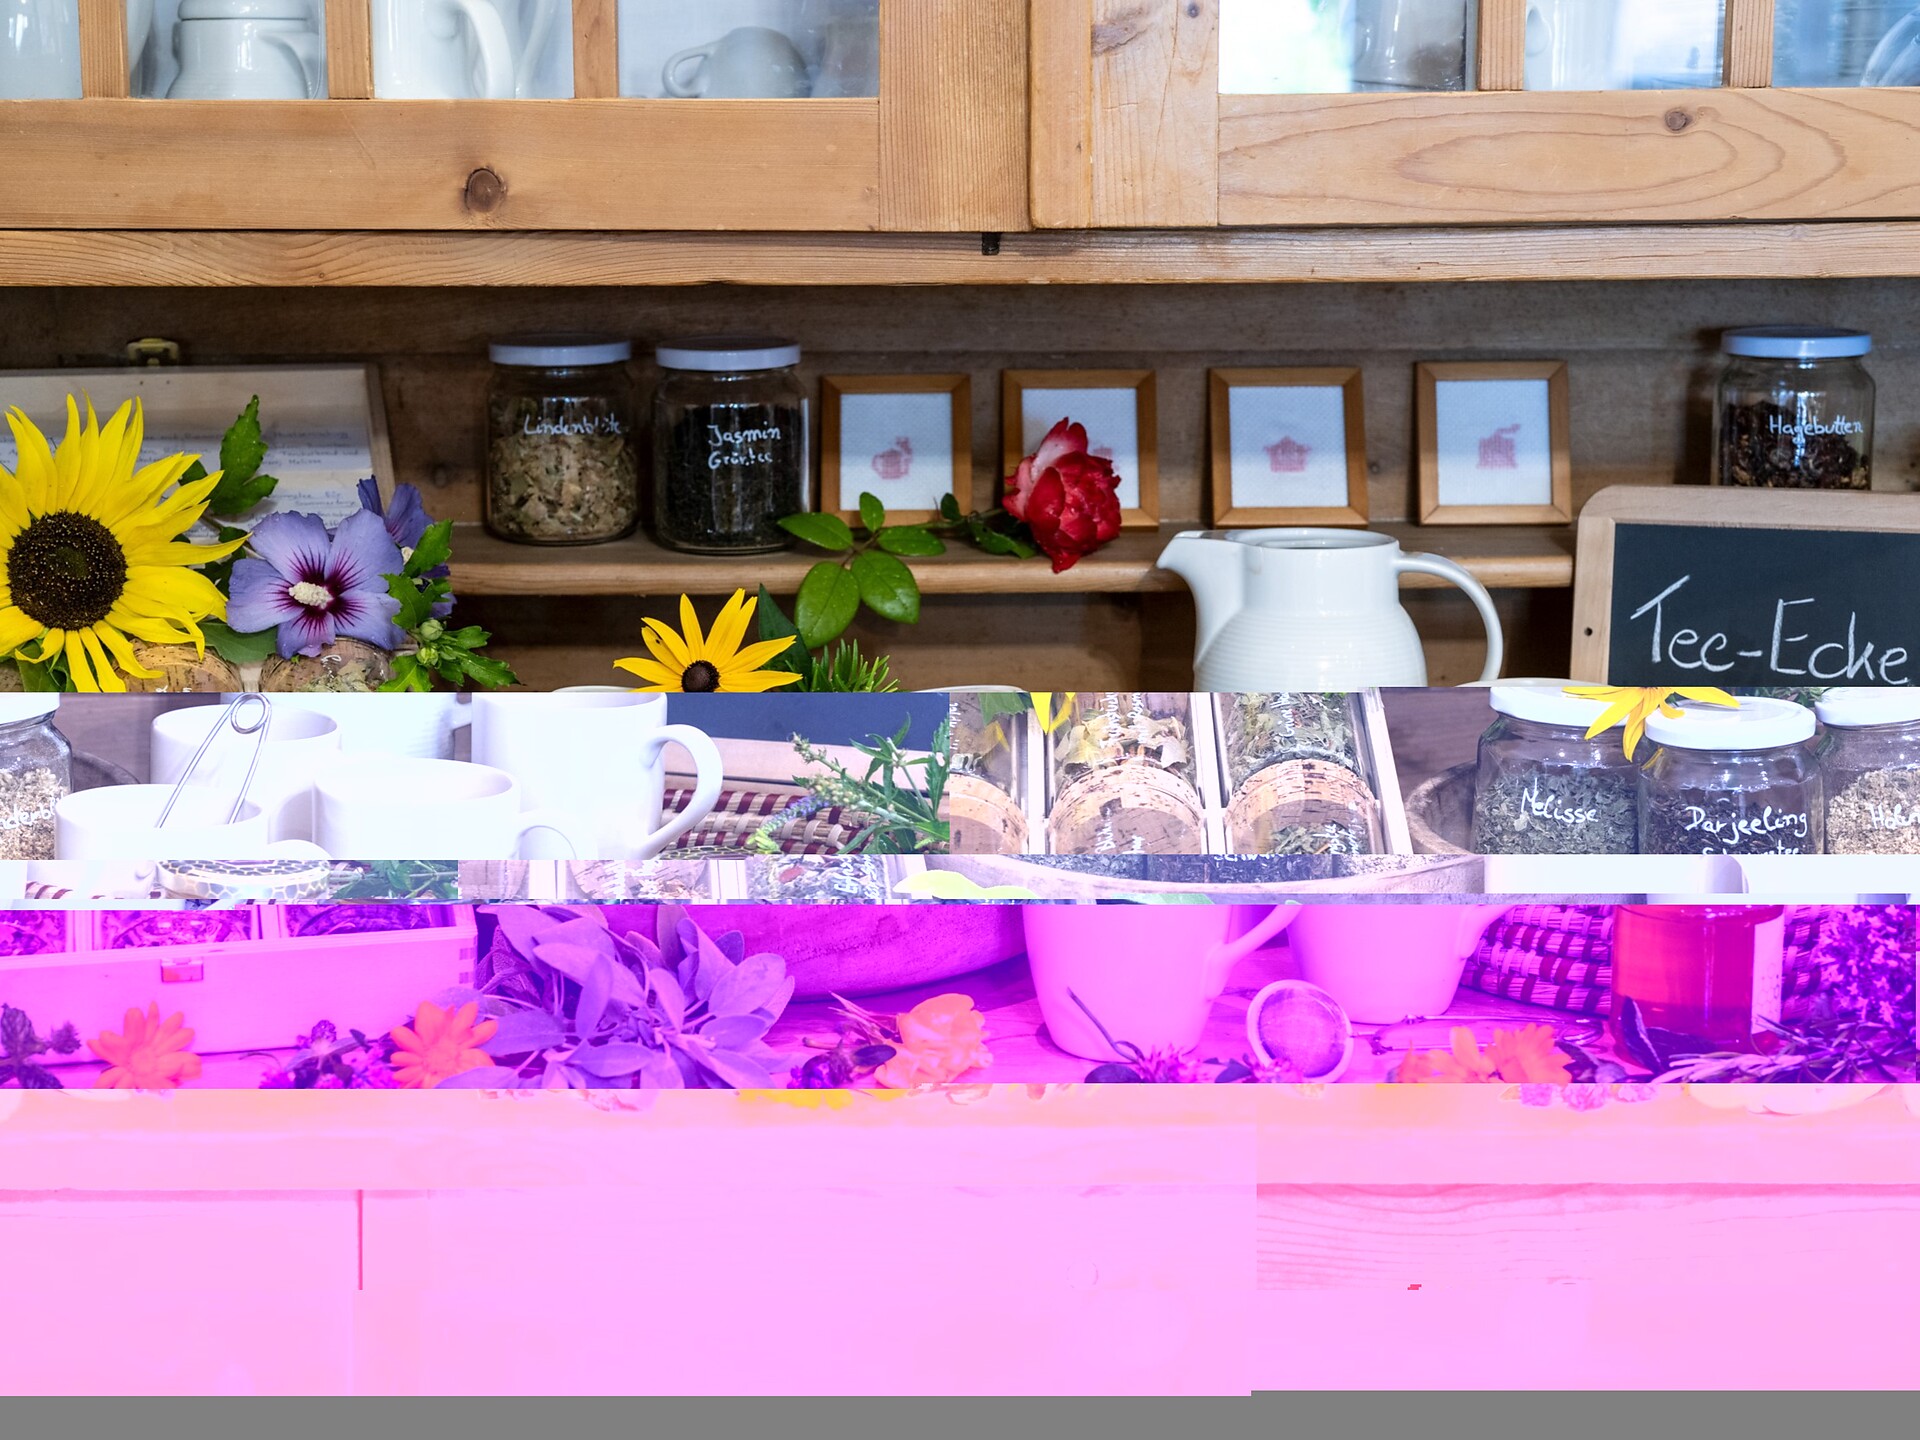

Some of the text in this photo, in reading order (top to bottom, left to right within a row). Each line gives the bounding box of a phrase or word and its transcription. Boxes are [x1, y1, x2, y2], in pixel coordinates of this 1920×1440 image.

[707, 421, 781, 446] Jasmin
[1769, 414, 1863, 445] Hagebutten
[1630, 574, 1909, 685] Tee-Ecke
[1521, 778, 1599, 823] Melisse
[1685, 805, 1808, 844] Darjeeling
